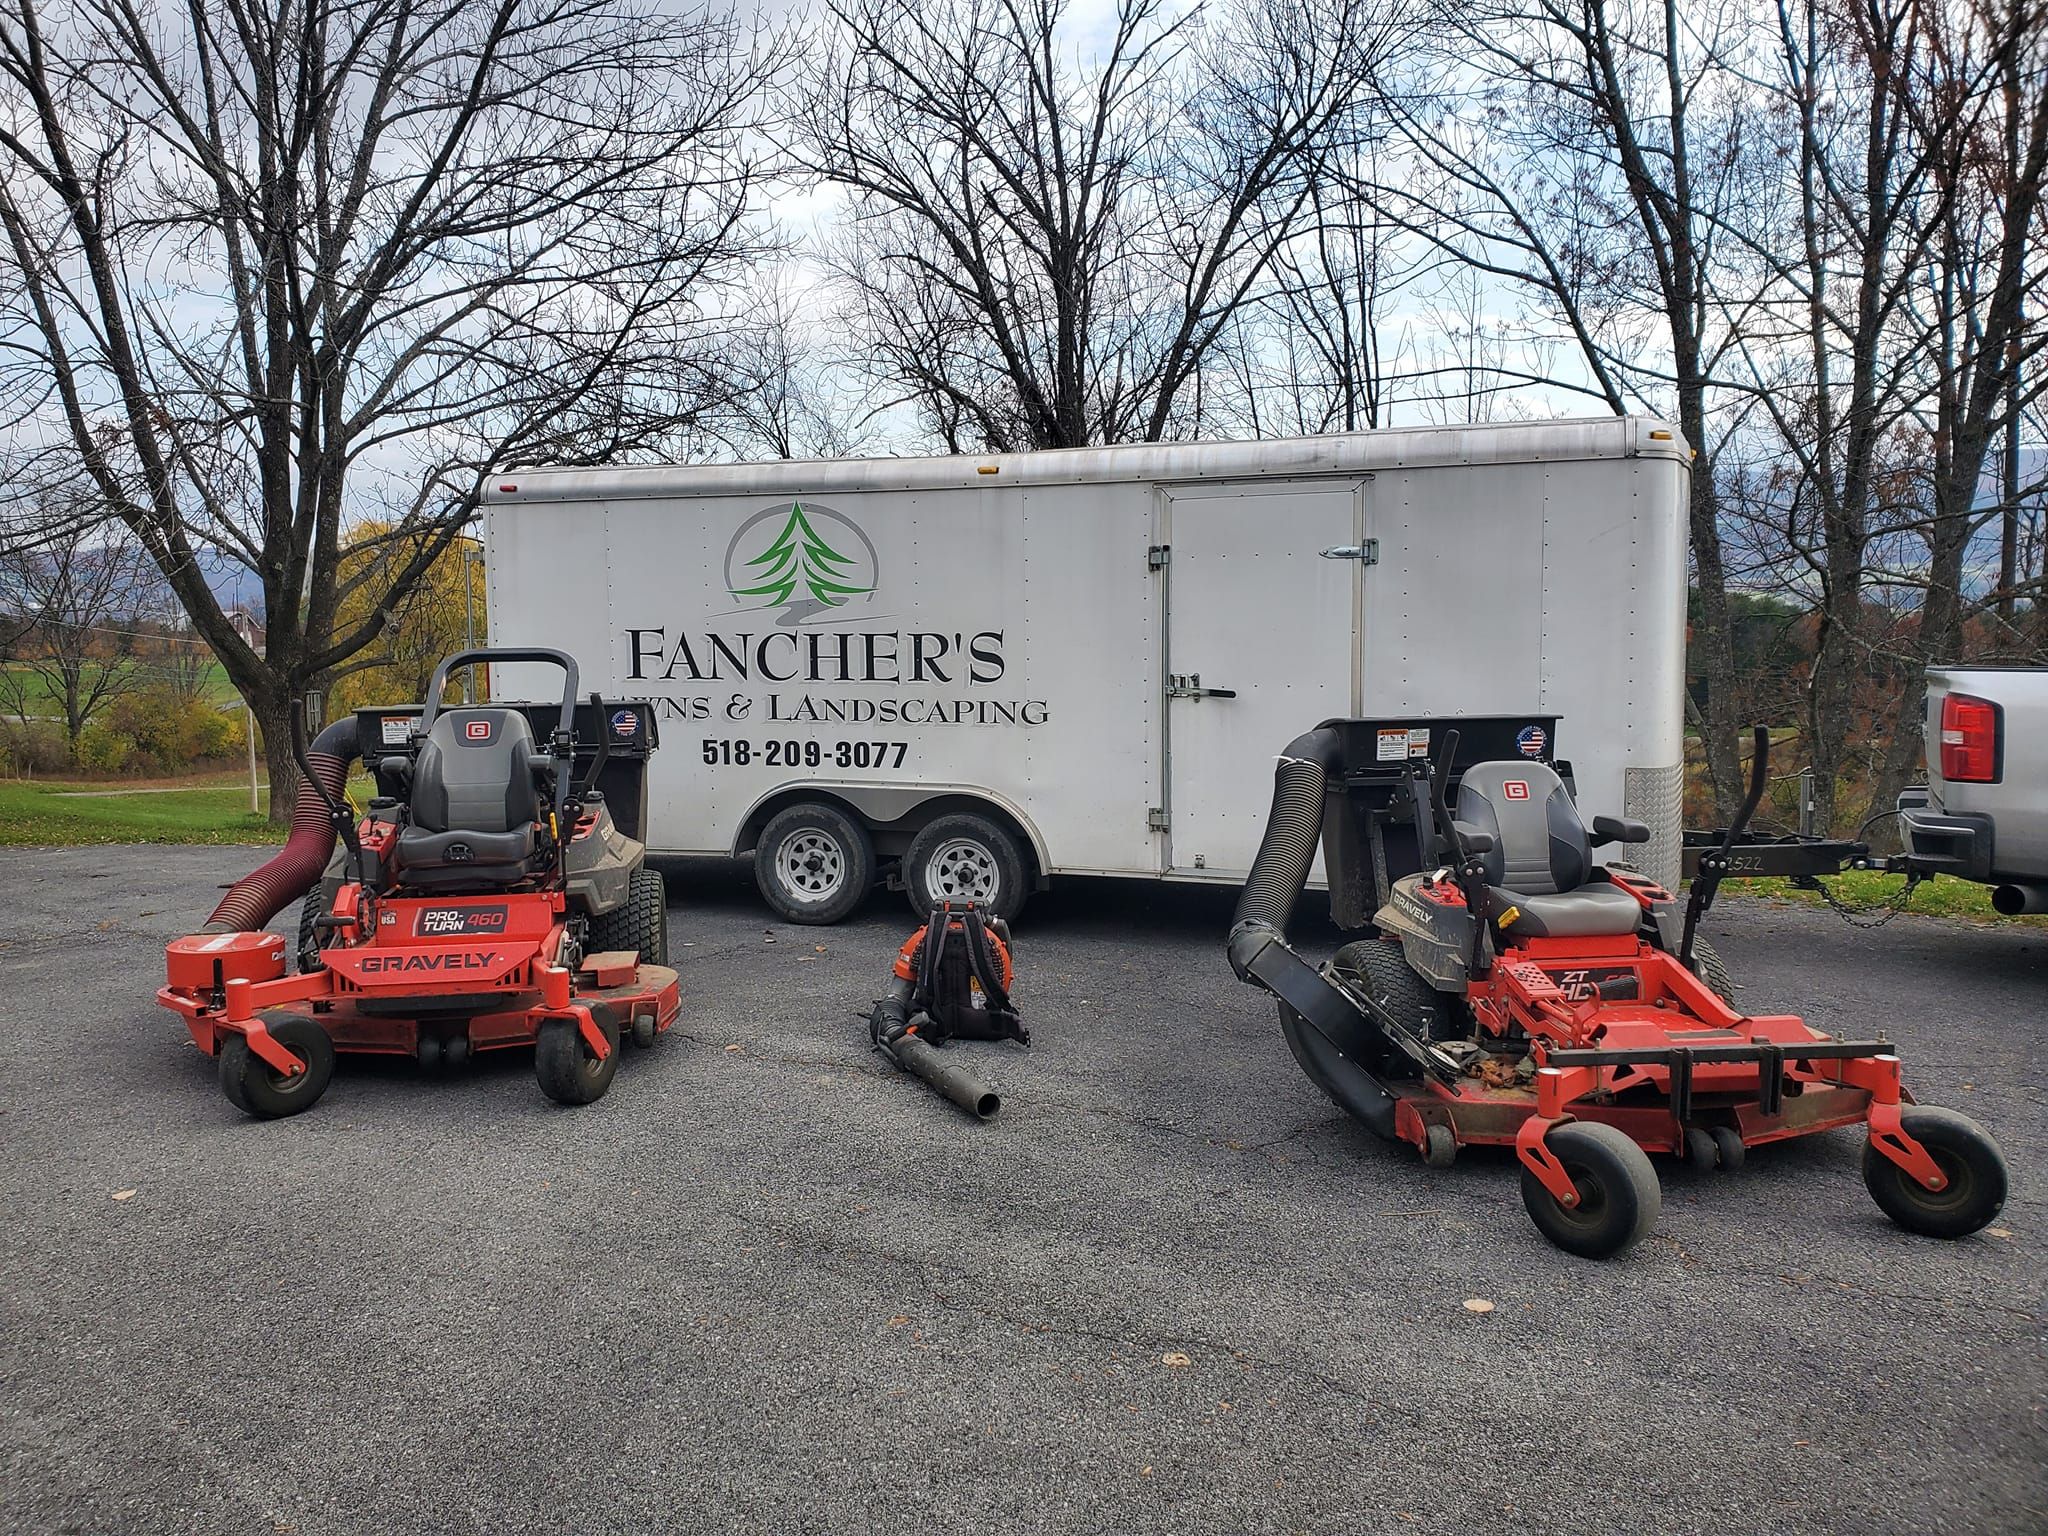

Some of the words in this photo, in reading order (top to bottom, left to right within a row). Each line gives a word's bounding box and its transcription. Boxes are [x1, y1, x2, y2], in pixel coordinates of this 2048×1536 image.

[624, 626, 1005, 686] FANCHER'S
[727, 693, 752, 720] &
[768, 693, 1051, 726] LANDSCAPING
[702, 739, 909, 769] 518-209-3077
[424, 911, 464, 921] PRO-
[467, 912, 504, 926] 460
[1393, 893, 1433, 924] GRAVELY
[423, 920, 465, 932] TURN
[361, 952, 497, 973] GRAVELY
[1561, 970, 1590, 983] ZT
